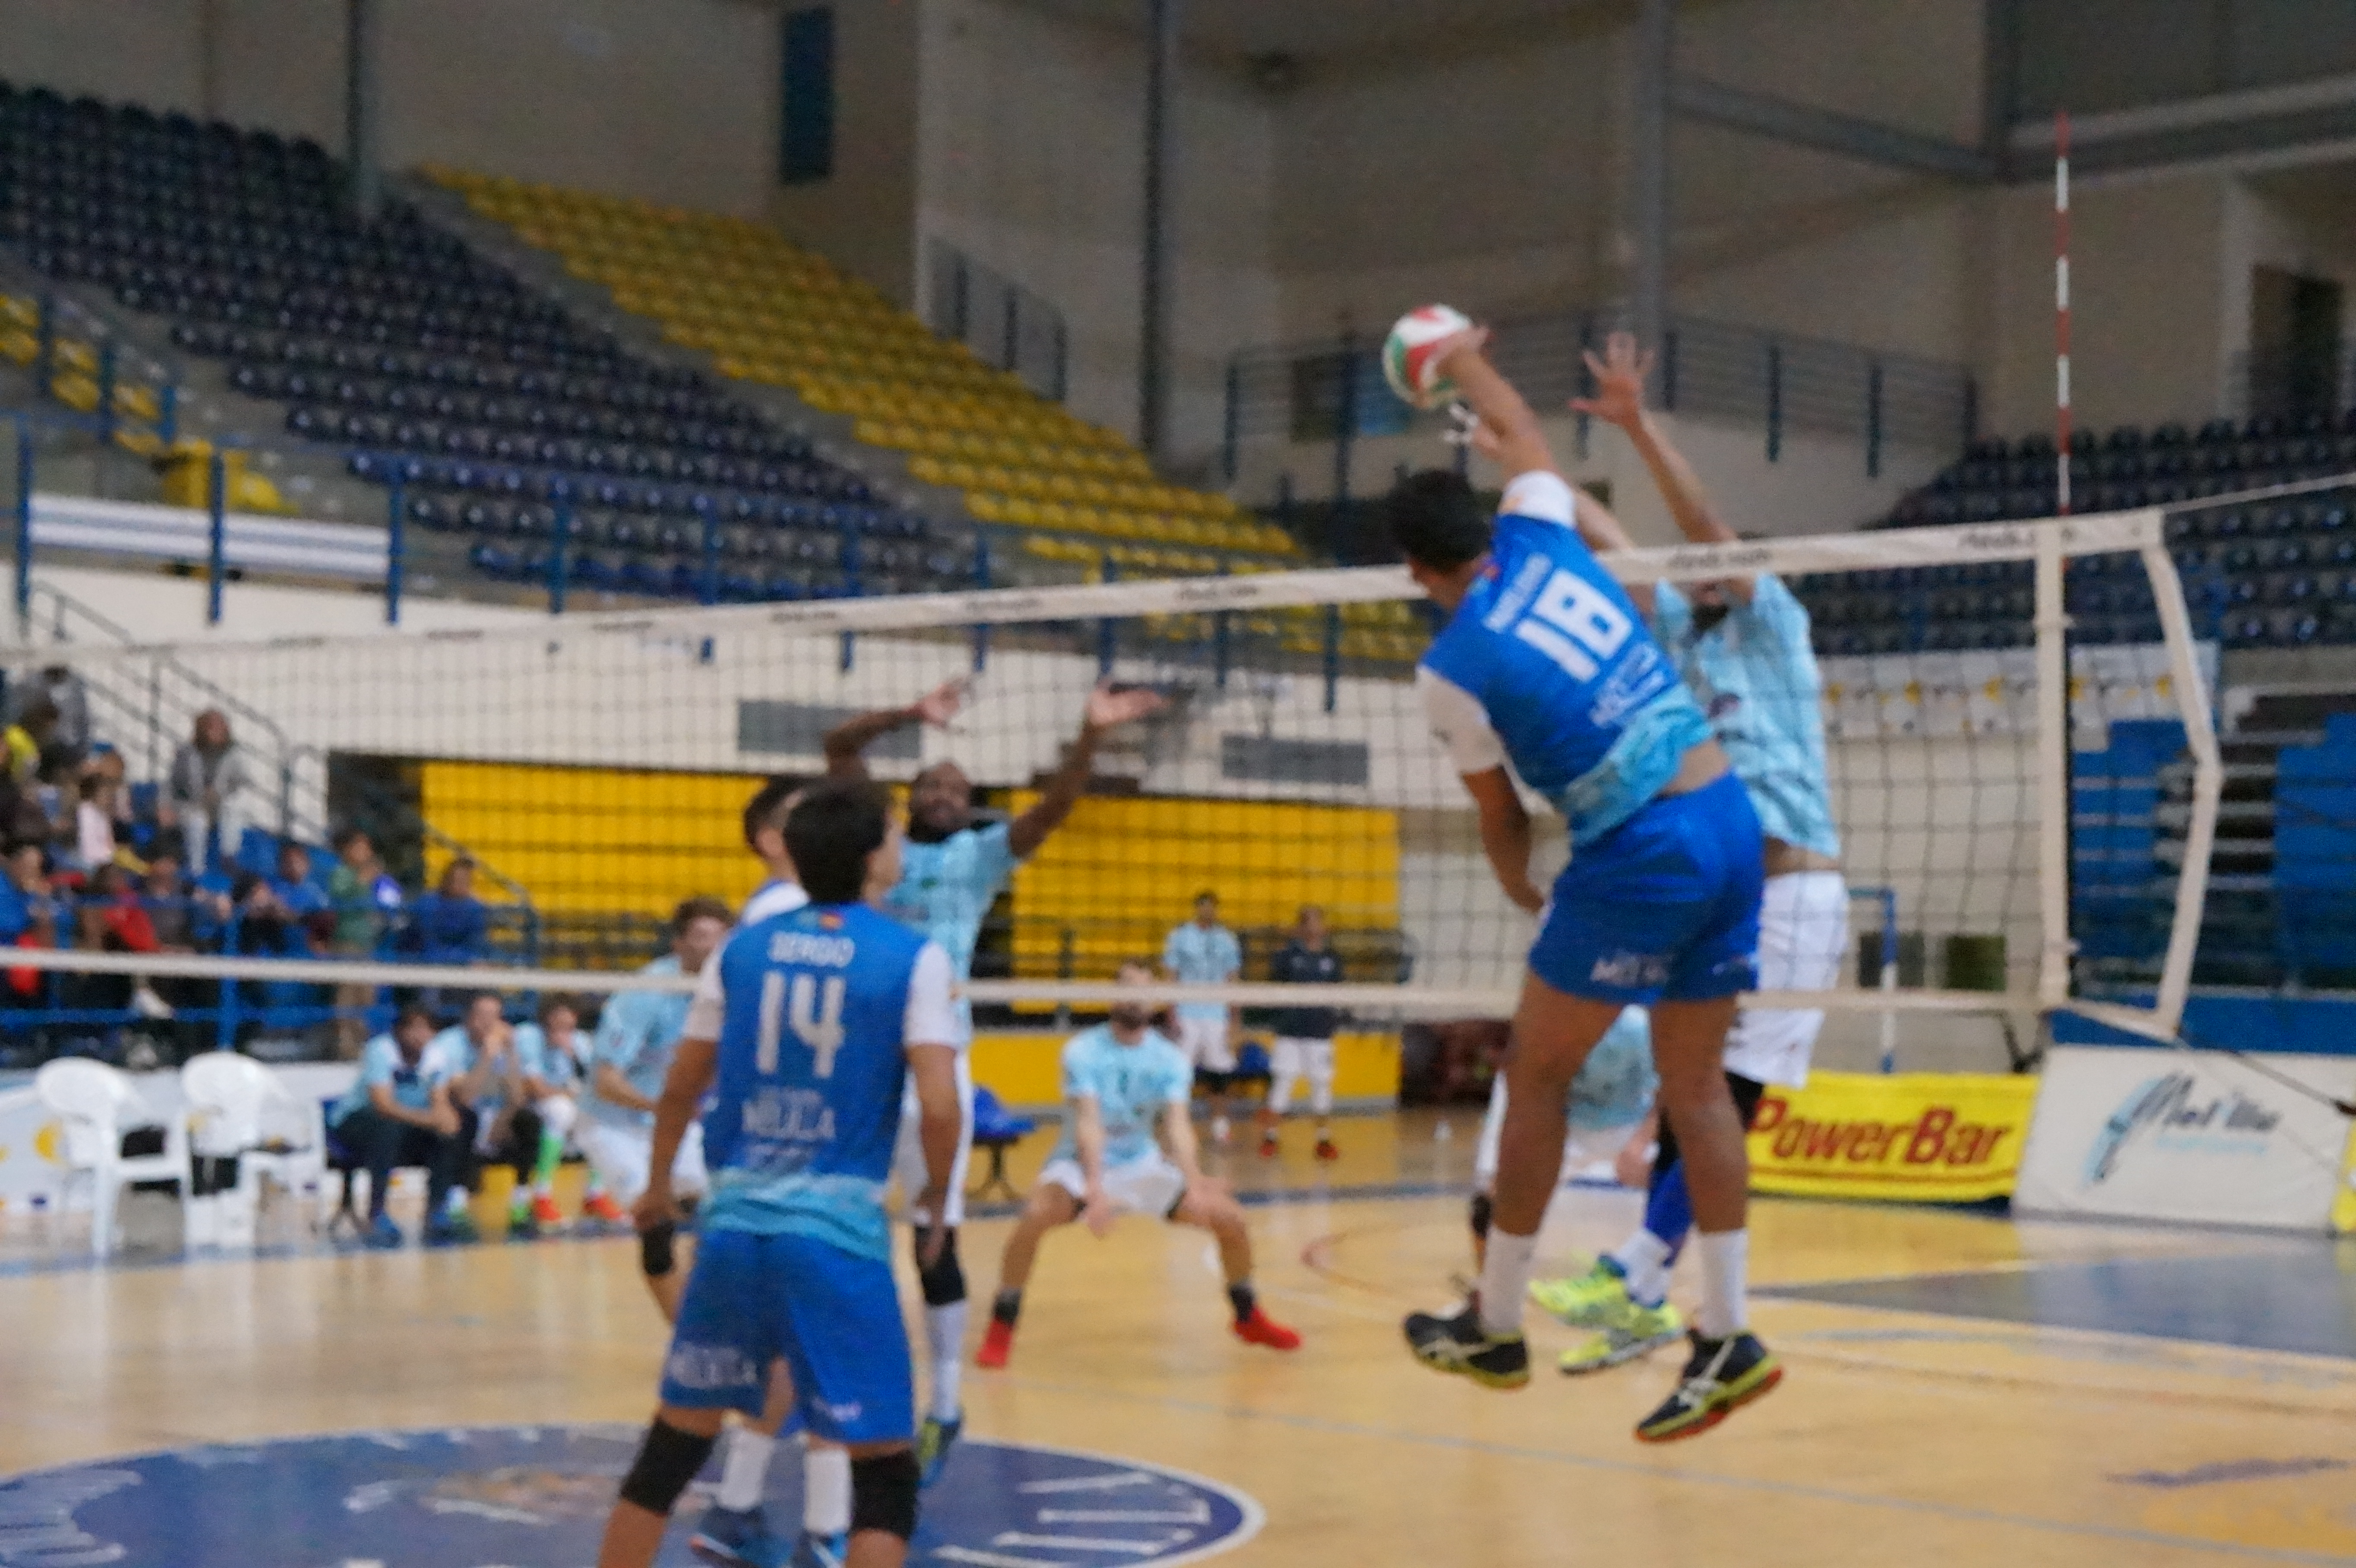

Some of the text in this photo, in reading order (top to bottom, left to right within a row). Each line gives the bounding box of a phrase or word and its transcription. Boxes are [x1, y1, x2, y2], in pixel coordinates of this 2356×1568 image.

[1515, 568, 1634, 683] 18
[768, 931, 856, 967] SERGIO
[756, 970, 847, 1078] 14
[1748, 1097, 2013, 1163] PowerBar
